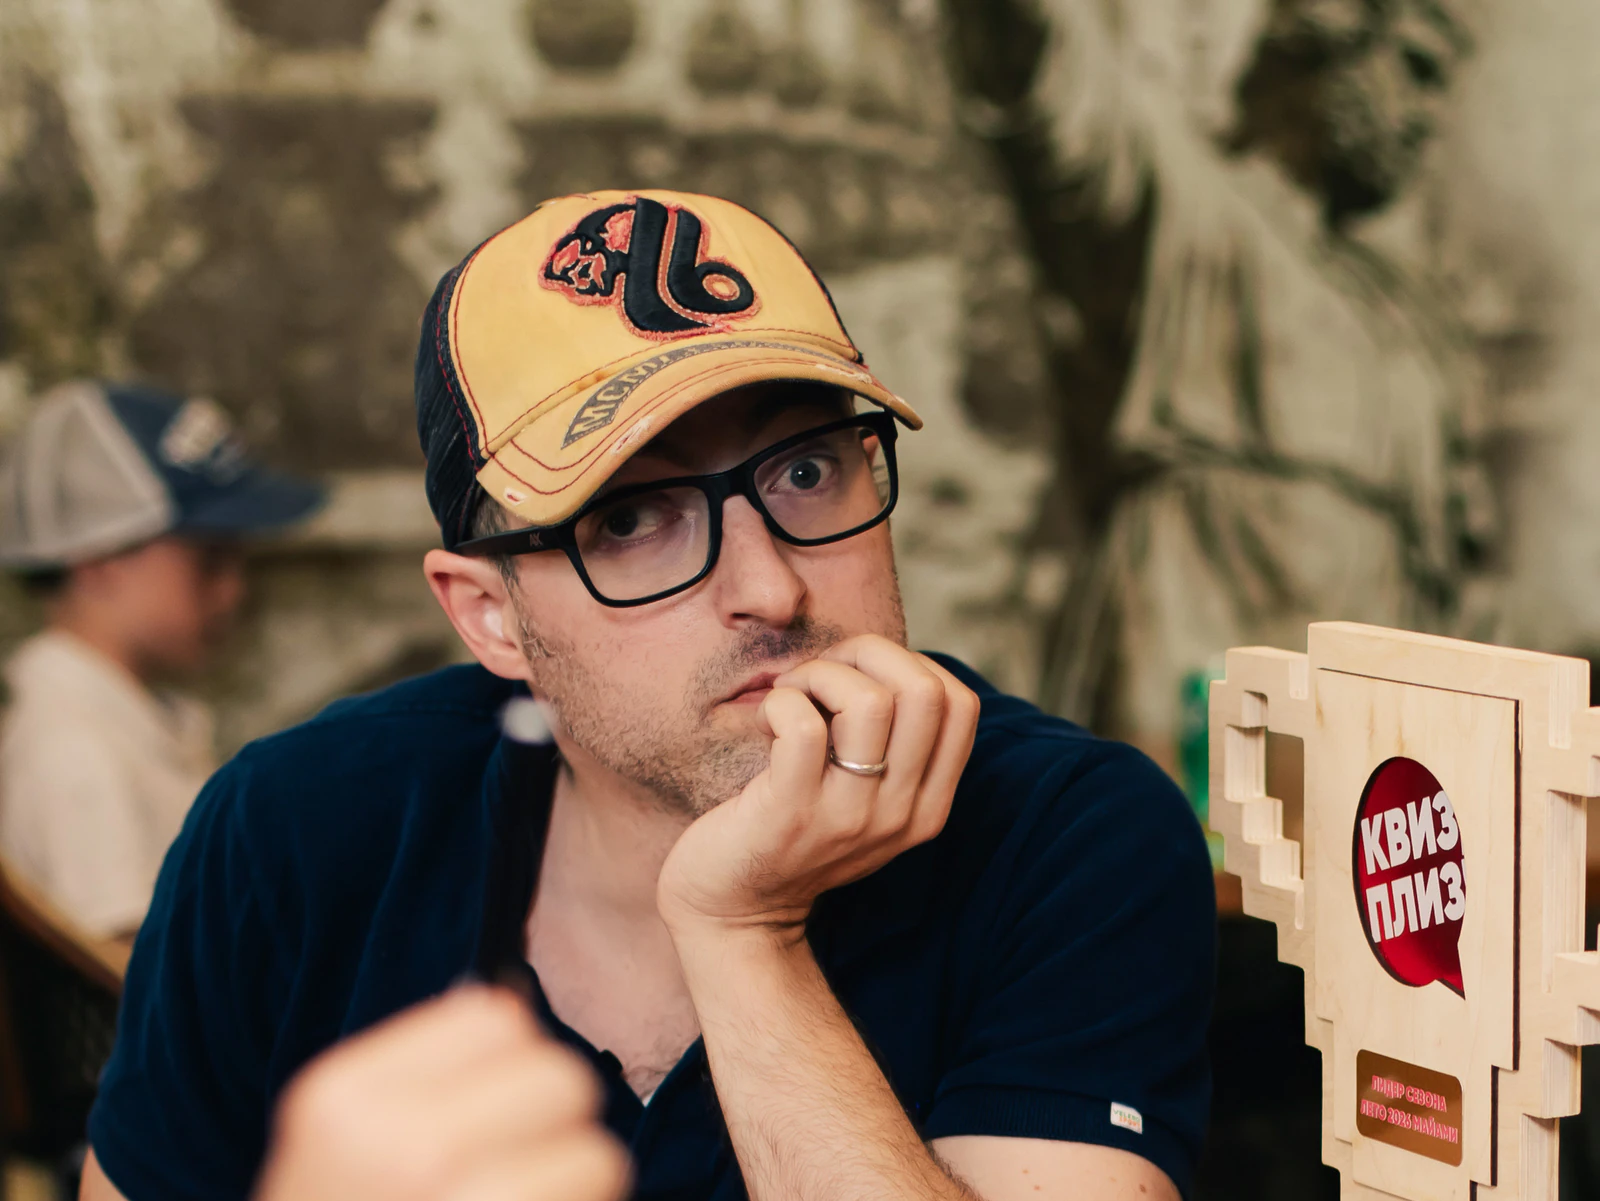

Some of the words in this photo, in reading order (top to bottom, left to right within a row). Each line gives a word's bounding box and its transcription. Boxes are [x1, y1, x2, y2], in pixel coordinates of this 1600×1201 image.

[1360, 790, 1459, 876] КВИЗ
[1365, 861, 1466, 944] ПЛИЗ
[1360, 1098, 1387, 1122] ЛЕТО
[1387, 1107, 1412, 1130] 2026
[1411, 1114, 1459, 1144] МАЙАМИ
[1371, 1074, 1405, 1099] ЛИДЕР
[1405, 1085, 1447, 1113] СЕЗОНА
